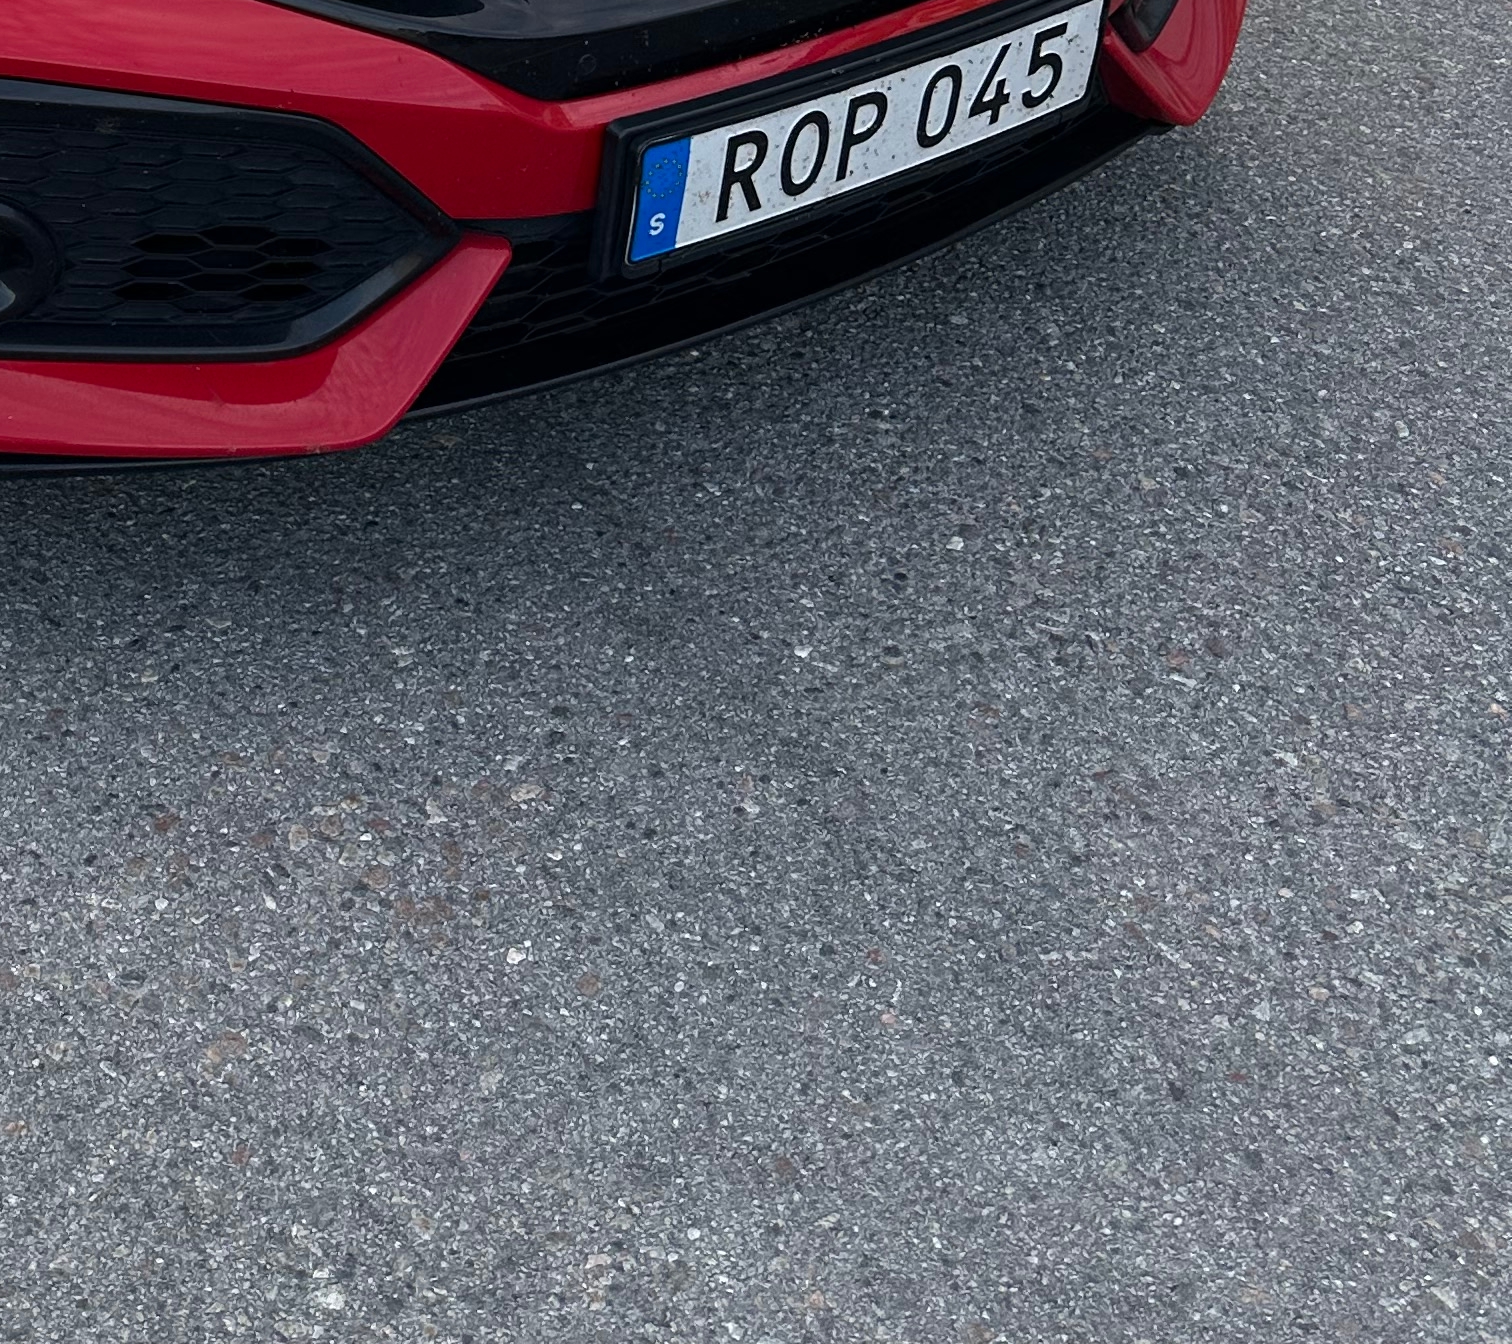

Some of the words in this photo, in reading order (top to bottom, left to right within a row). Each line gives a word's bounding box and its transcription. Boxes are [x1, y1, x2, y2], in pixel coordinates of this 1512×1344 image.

[714, 91, 888, 223] ROP
[915, 21, 1069, 149] 045
[649, 212, 666, 236] S
